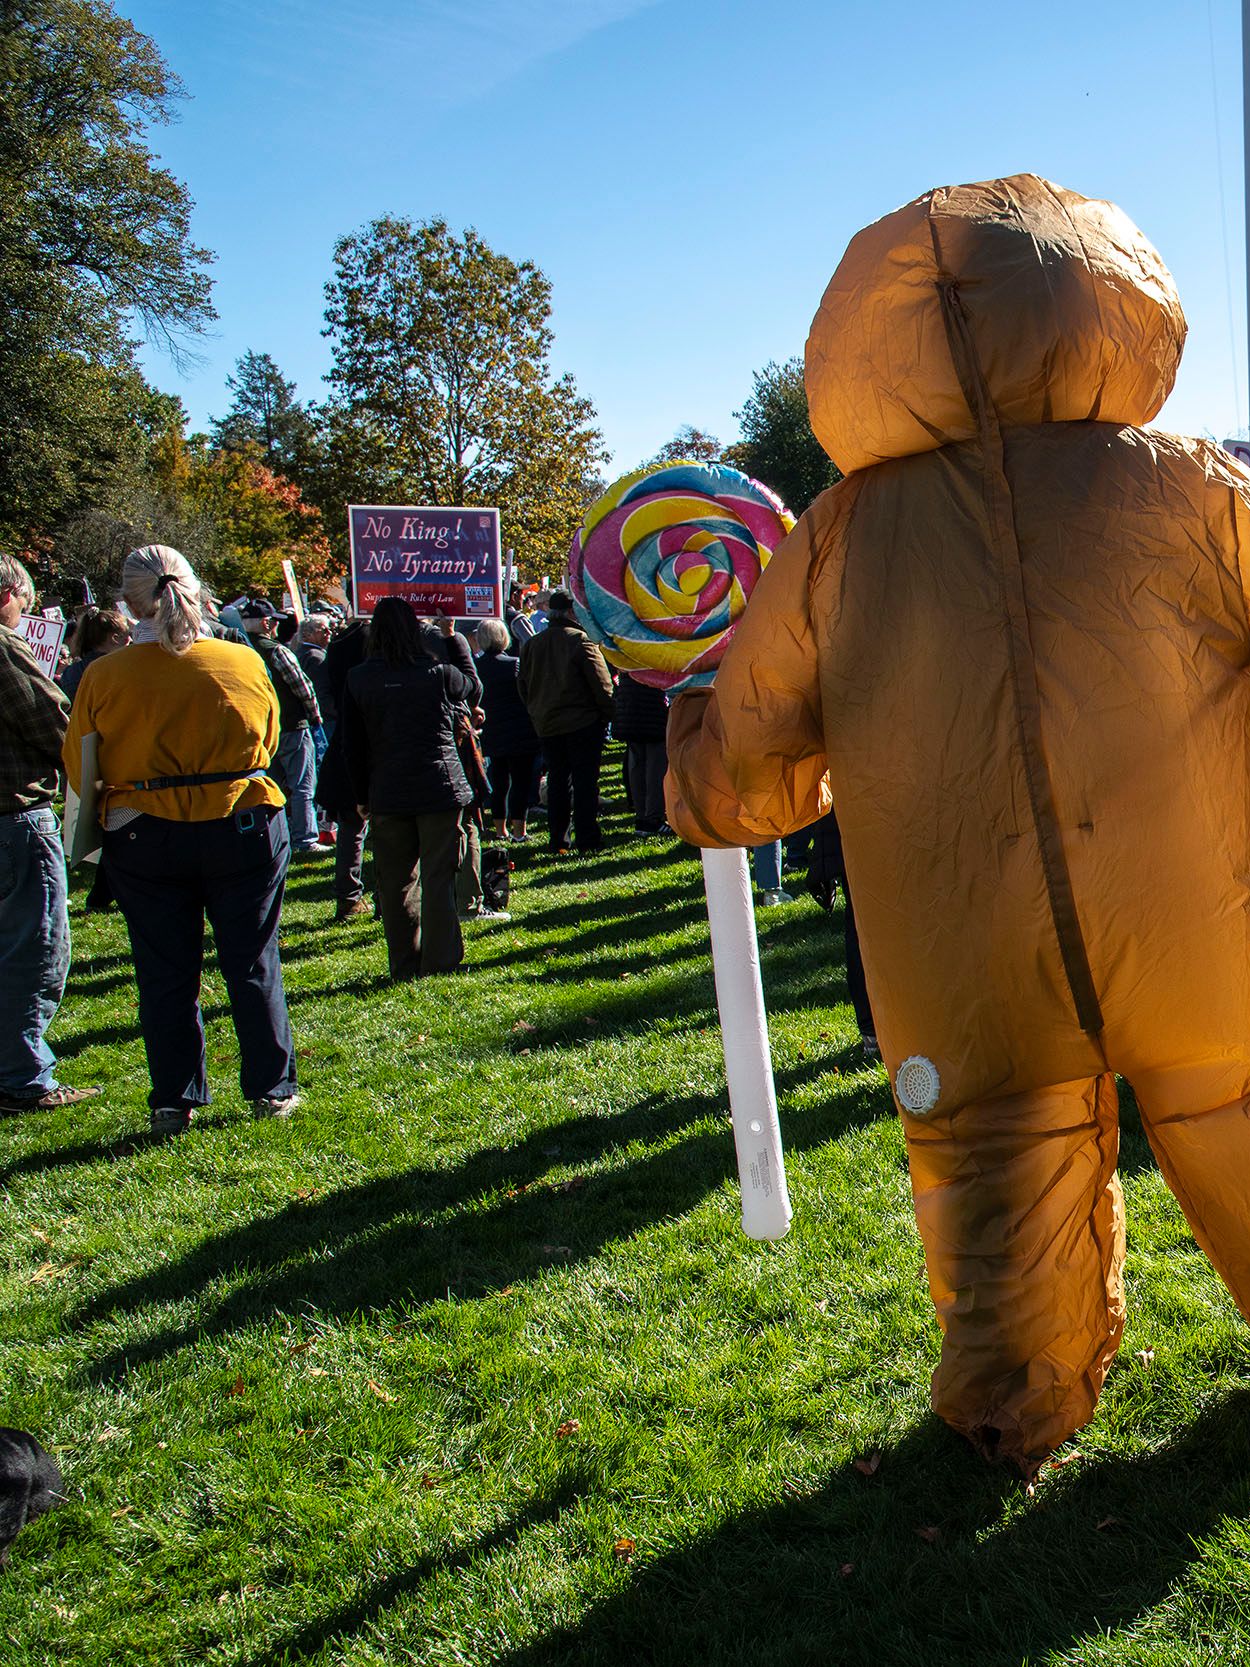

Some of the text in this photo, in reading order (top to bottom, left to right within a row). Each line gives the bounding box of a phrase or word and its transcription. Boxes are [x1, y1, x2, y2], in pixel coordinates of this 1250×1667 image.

[361, 516, 391, 539] No
[363, 550, 393, 572] No
[364, 592, 394, 605] Supp
[409, 592, 426, 603] Rule
[428, 593, 437, 604] of
[26, 620, 47, 640] NO
